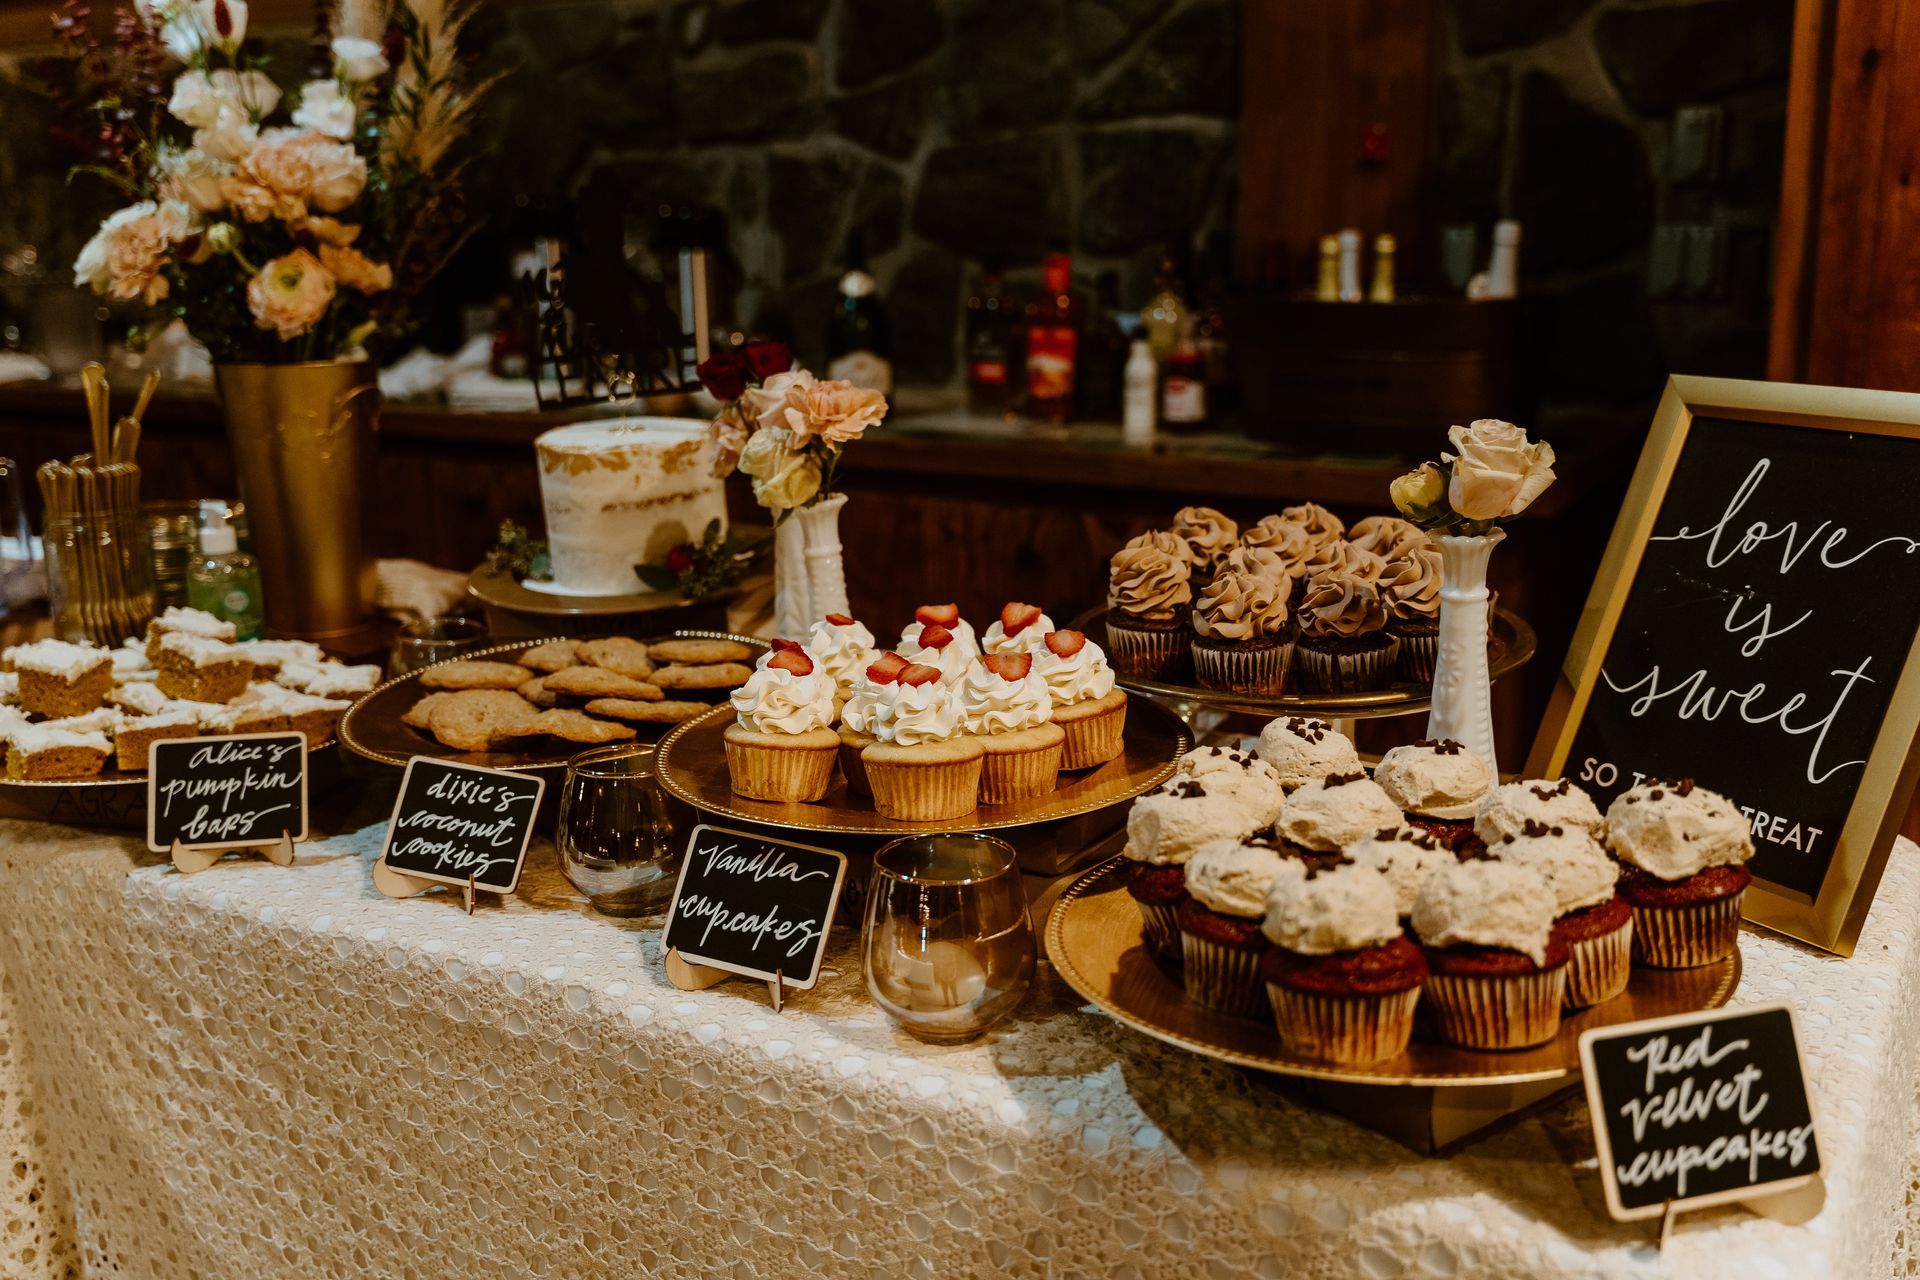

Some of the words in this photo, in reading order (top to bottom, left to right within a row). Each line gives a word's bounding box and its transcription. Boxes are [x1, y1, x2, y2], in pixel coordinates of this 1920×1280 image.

[1650, 458, 1920, 574] love
[1725, 584, 1813, 657] is
[1601, 656, 1876, 784] sweet
[160, 766, 303, 818] pumpkin
[427, 773, 535, 812] dixie's
[1580, 757, 1618, 787] SO
[1740, 805, 1823, 854] TREAT
[391, 837, 515, 878] cookies
[398, 810, 516, 847] coconut
[679, 894, 821, 957] cupcakes
[1616, 1122, 1814, 1196] cupcakes
